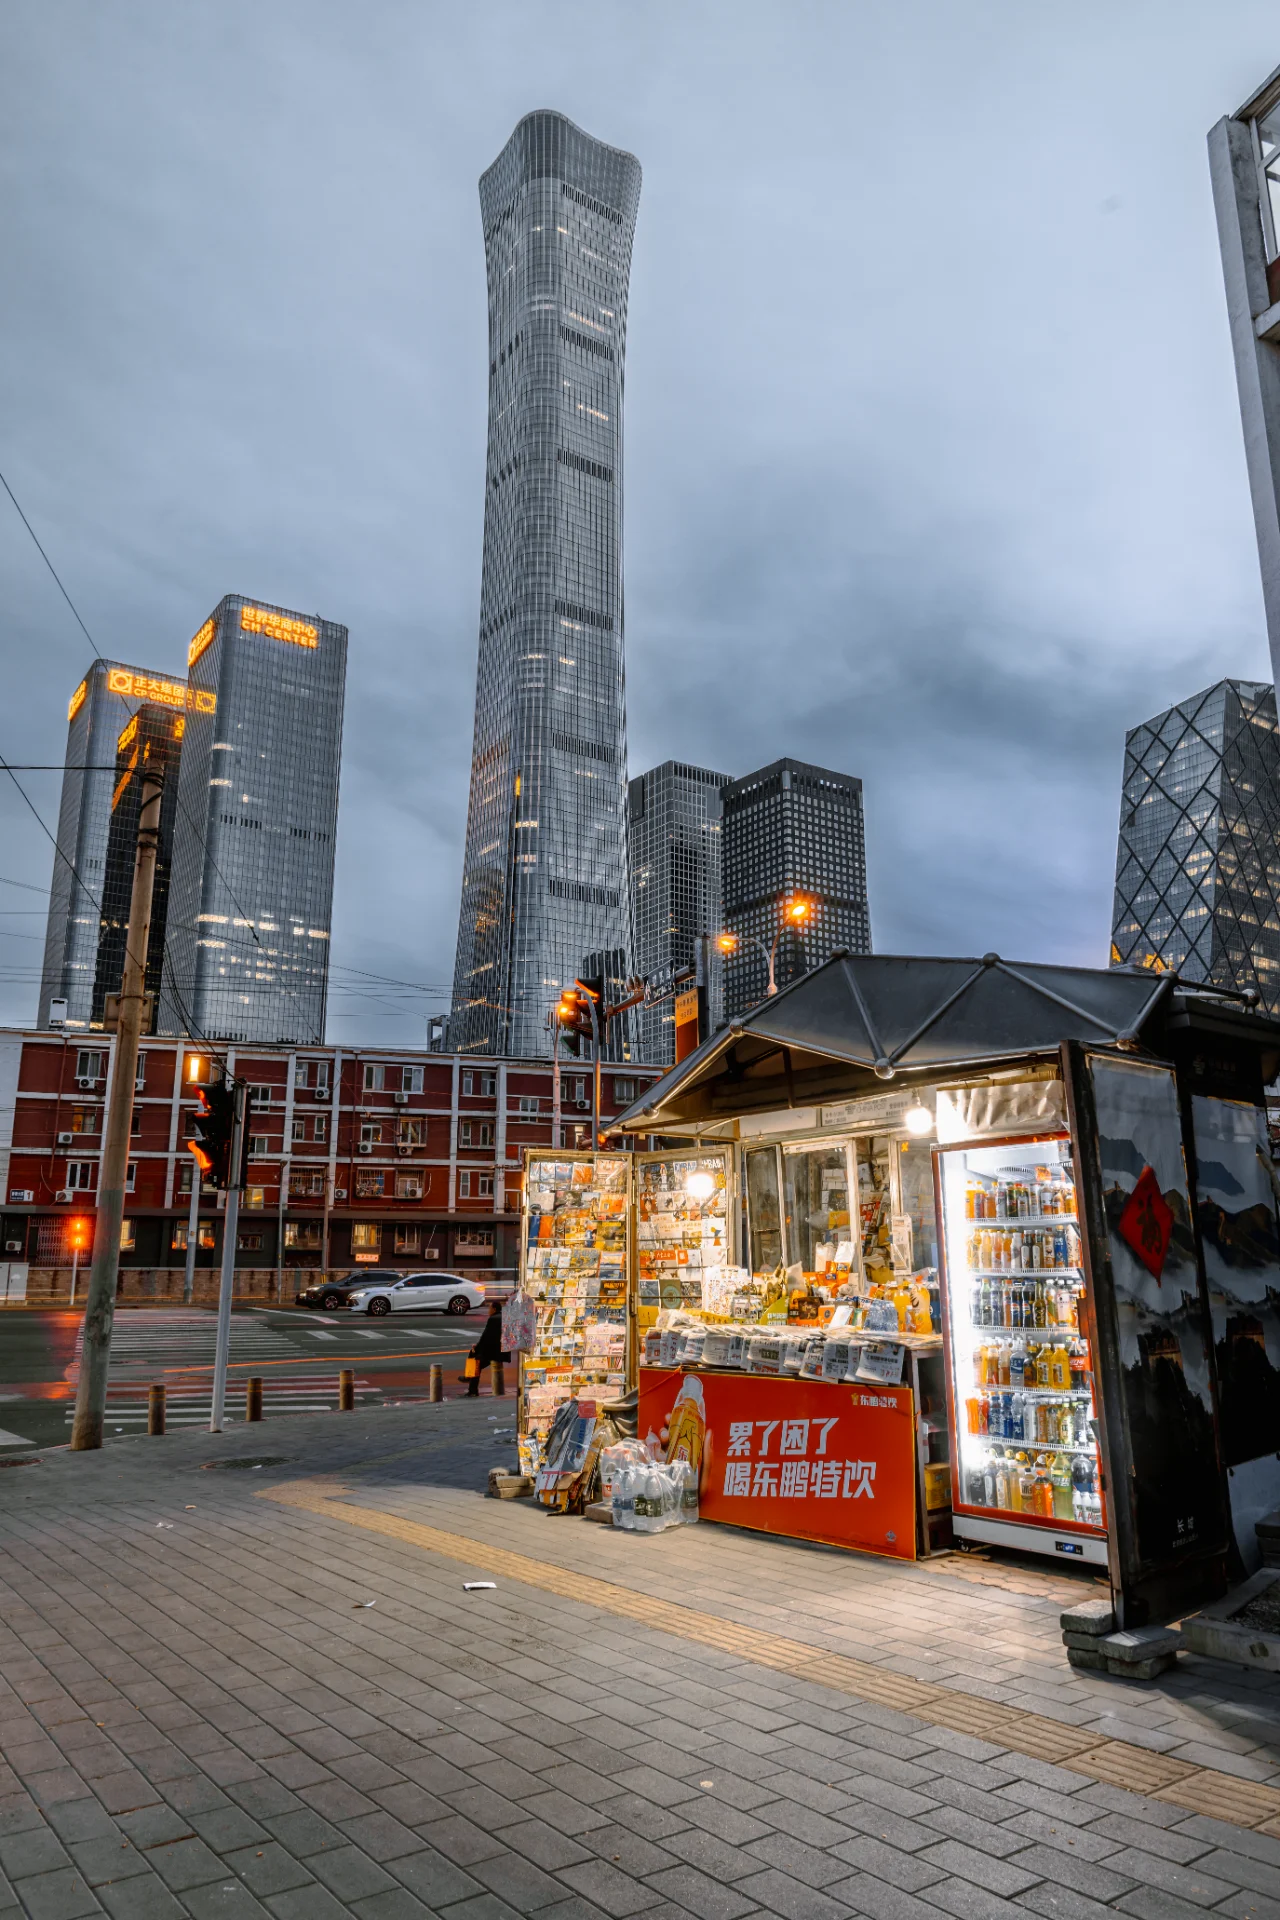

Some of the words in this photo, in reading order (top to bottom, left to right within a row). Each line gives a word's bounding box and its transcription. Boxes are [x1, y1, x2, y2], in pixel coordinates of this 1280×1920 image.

[242, 606, 318, 638] 世界华商中心
[265, 626, 318, 649] CENTER
[133, 676, 185, 697] 正大集团
[133, 688, 148, 697] CP
[149, 692, 185, 705] GROUP
[860, 1394, 898, 1409] 东鹏特饮
[726, 1417, 840, 1457] 累了困了
[722, 1459, 877, 1499] 喝东鹏特饮
